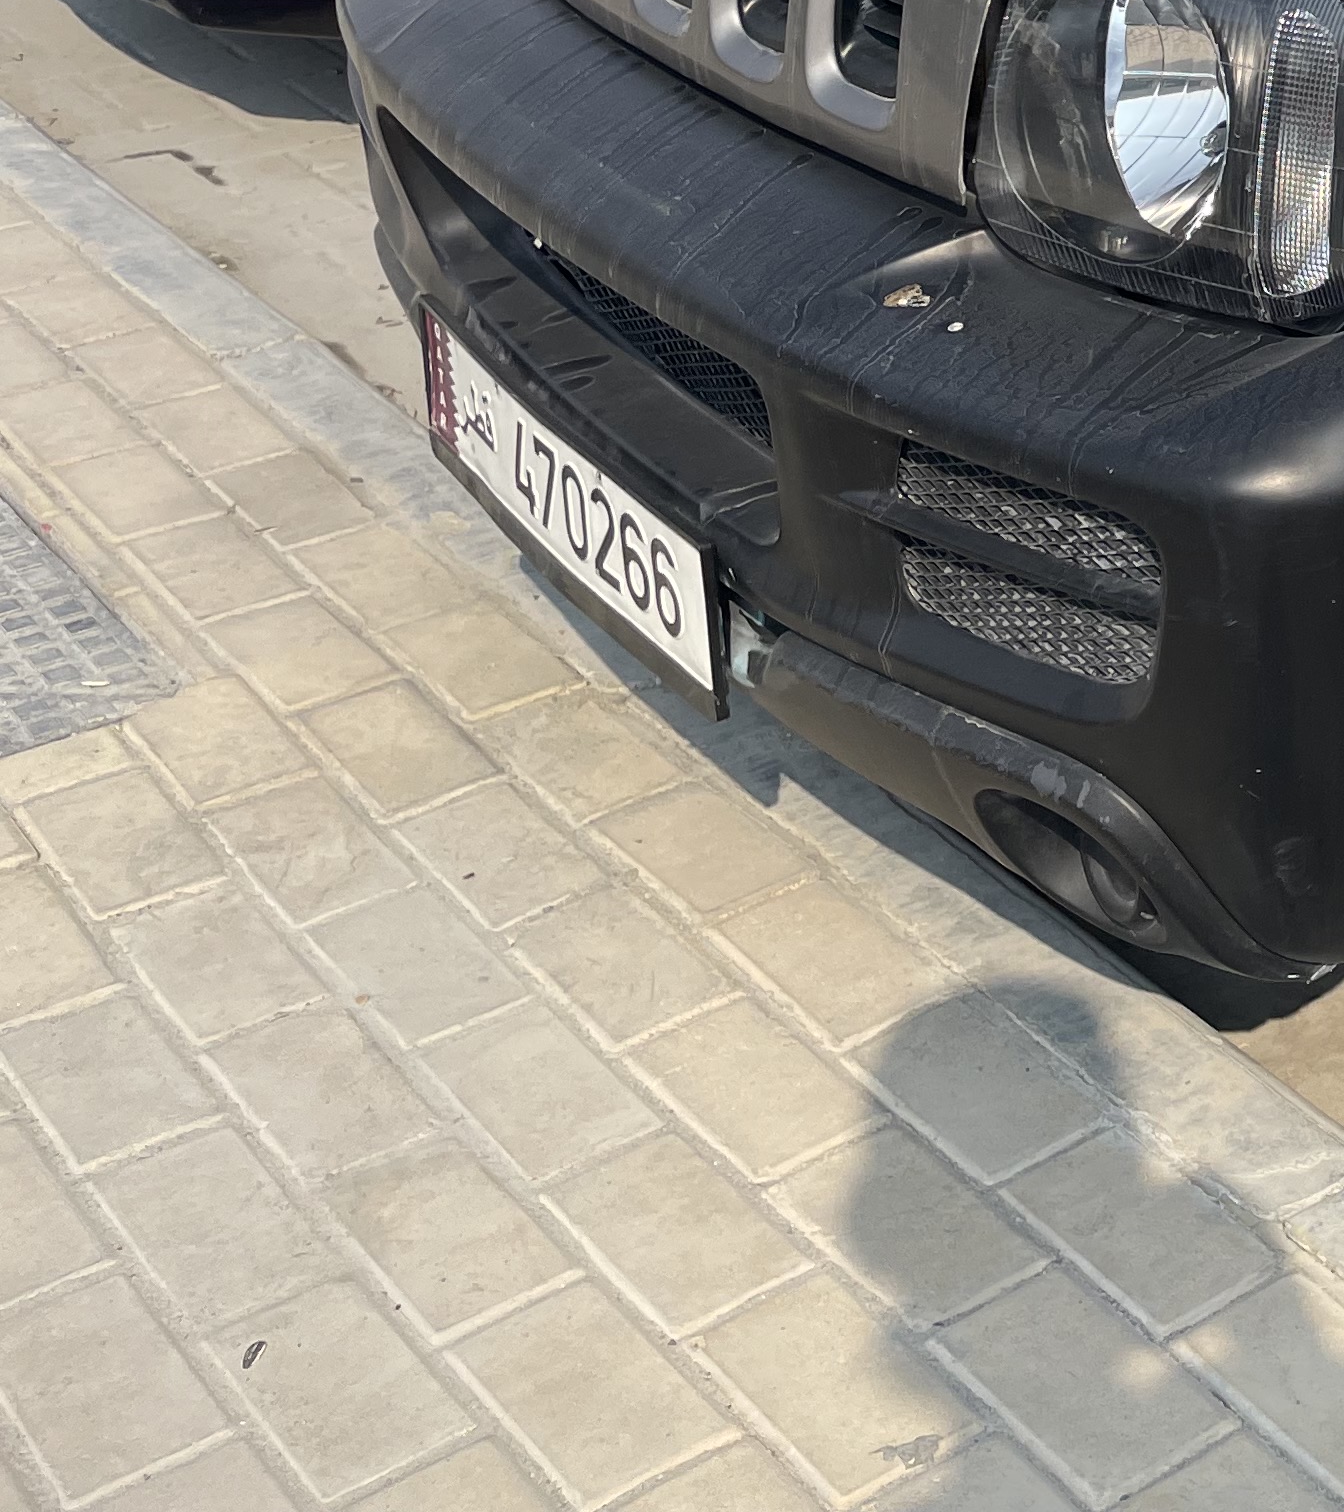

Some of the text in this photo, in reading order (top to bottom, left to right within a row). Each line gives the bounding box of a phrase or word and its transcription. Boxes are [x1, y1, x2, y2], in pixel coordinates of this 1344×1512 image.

[434, 322, 447, 431] QATAR
[460, 379, 498, 453] قطر
[515, 418, 686, 640] 470266
